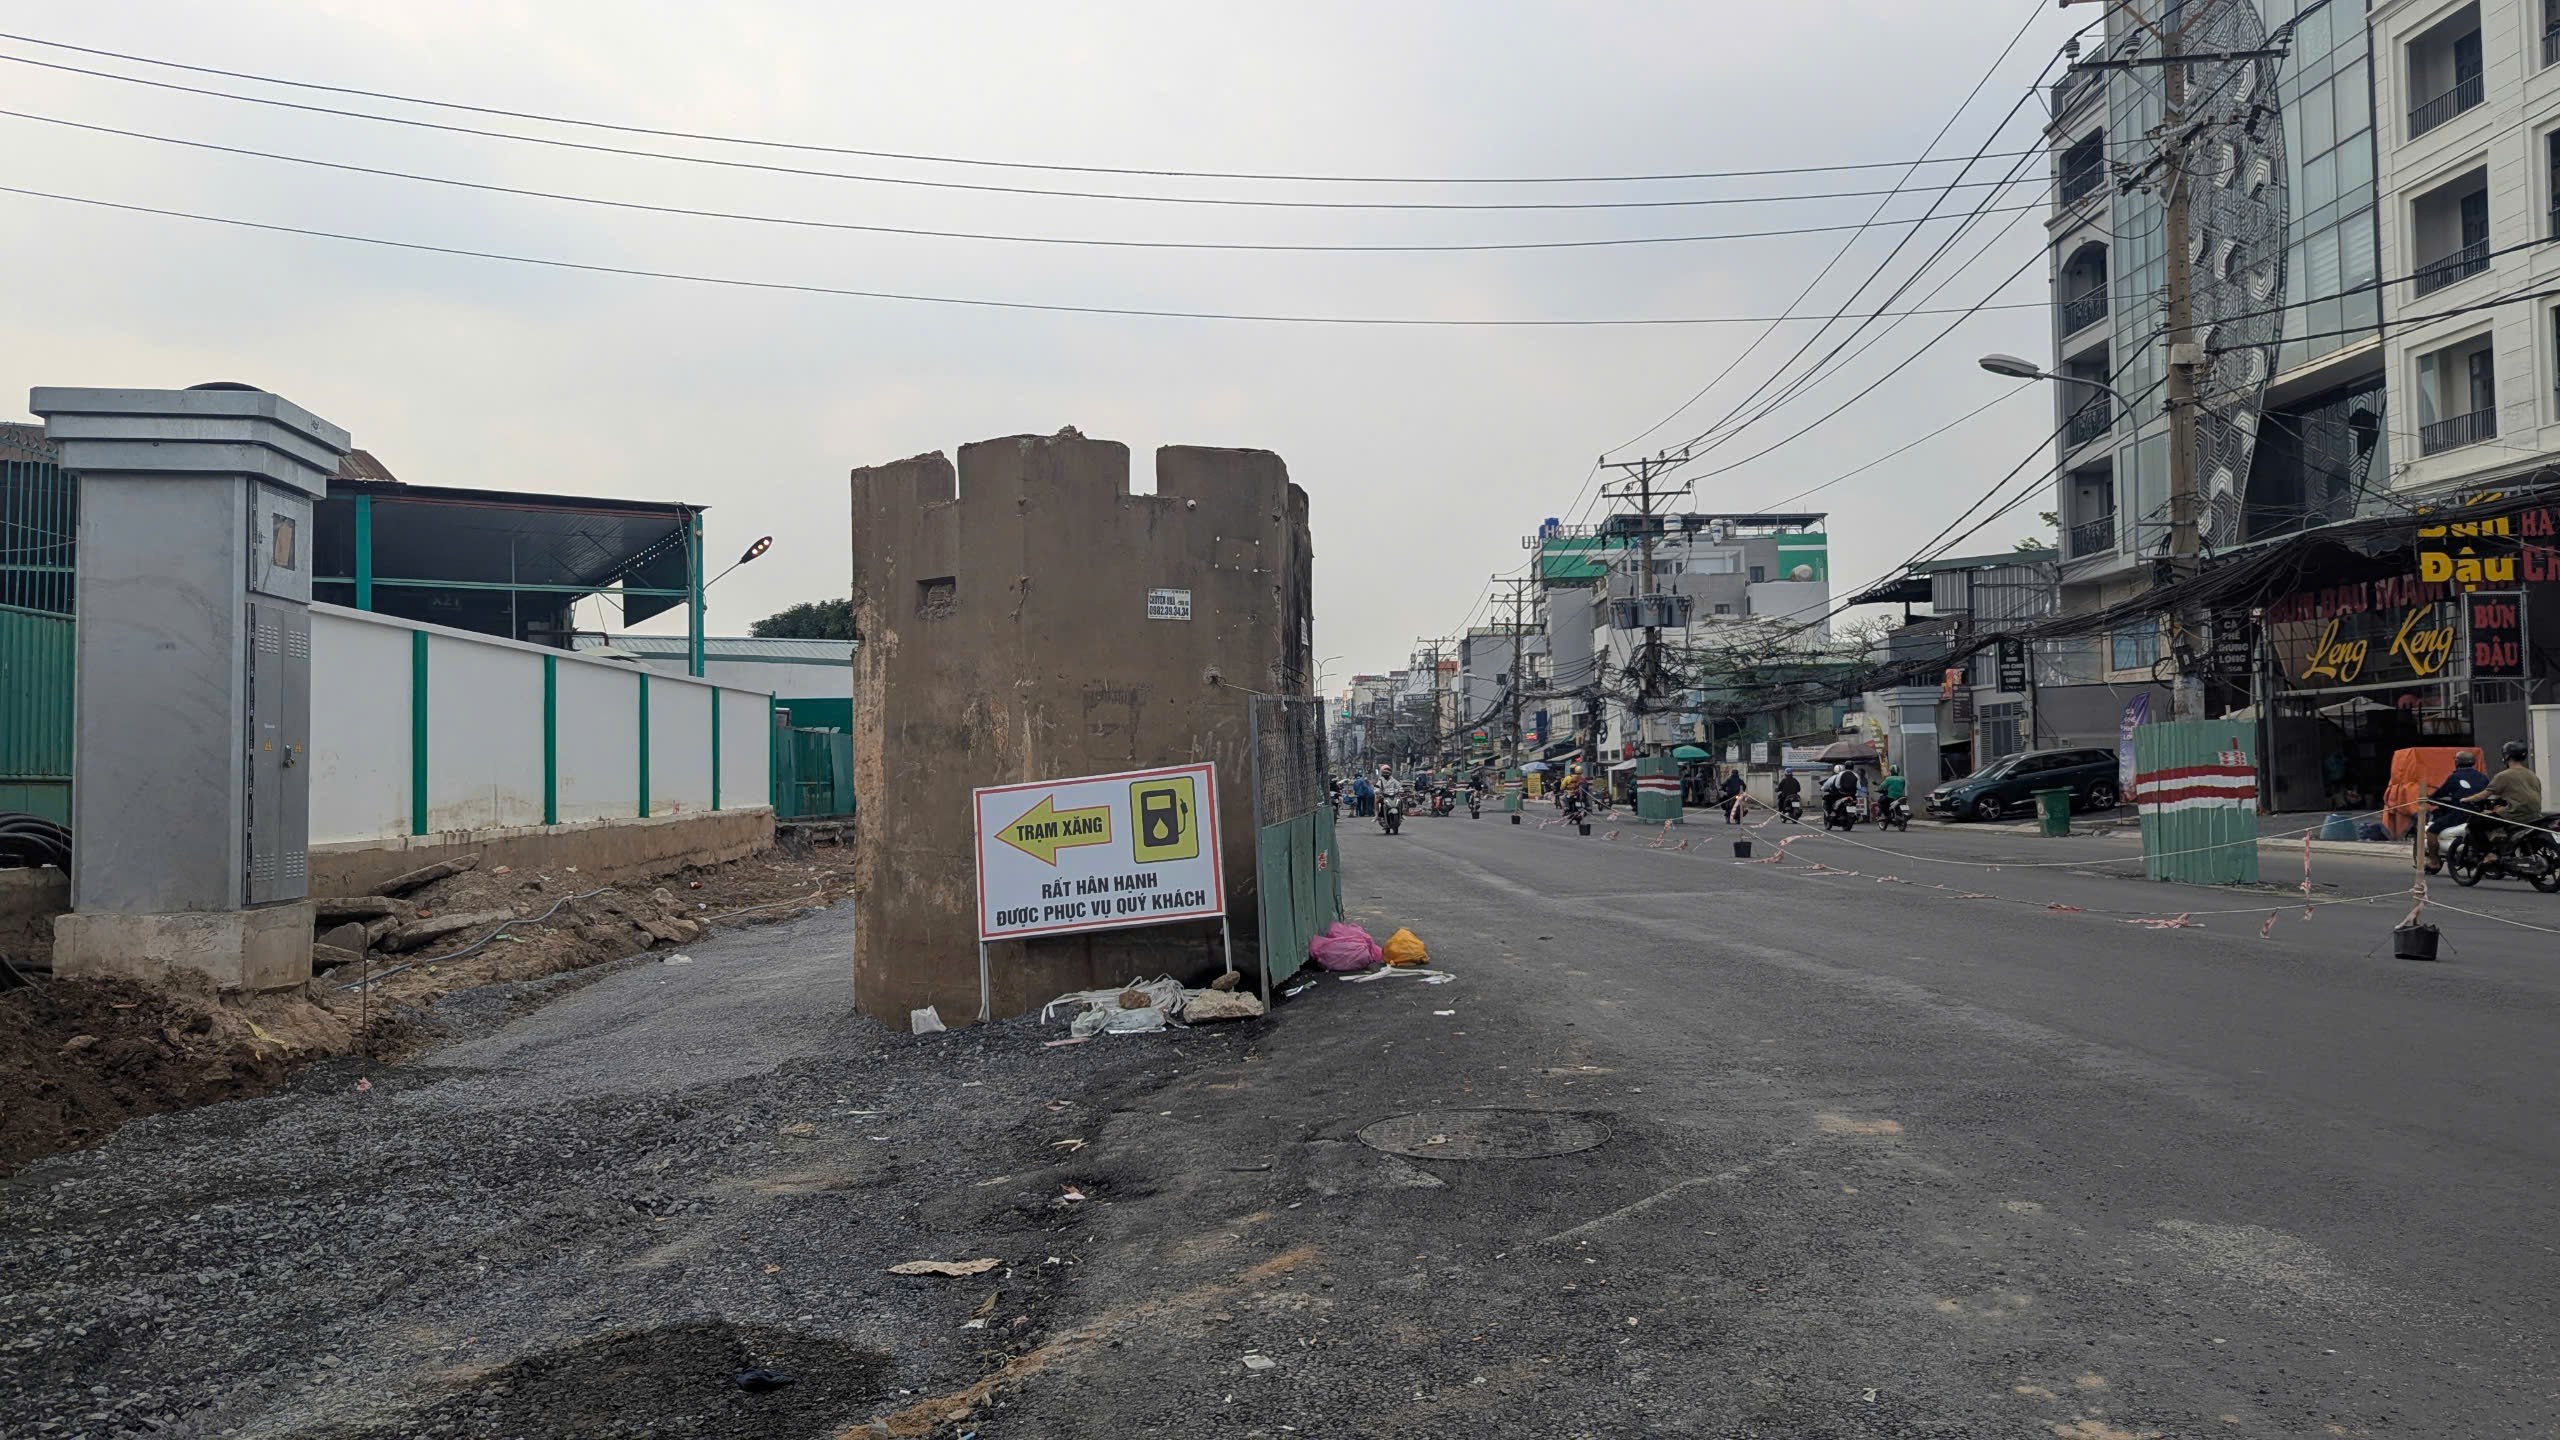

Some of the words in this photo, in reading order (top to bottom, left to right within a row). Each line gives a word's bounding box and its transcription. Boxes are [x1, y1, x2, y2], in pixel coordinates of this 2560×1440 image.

[2419, 546, 2515, 592] Đậu
[2474, 600, 2516, 629] BÚN
[2302, 618, 2368, 683] Leng
[2389, 603, 2455, 676] Keng
[2475, 637, 2519, 672] ĐẬU
[1016, 823, 1058, 843] TRẠM
[1062, 816, 1103, 837] XĂNG
[1041, 876, 1072, 899] RẤT
[1076, 875, 1109, 895] HÂN
[1114, 872, 1158, 894] HẠNH
[996, 905, 1039, 928] ĐƯỢC
[1044, 901, 1086, 924] PHỤC
[1091, 900, 1112, 918] VỤ
[1116, 892, 1147, 916] QUÝ
[1152, 888, 1206, 910] KHÁCH
